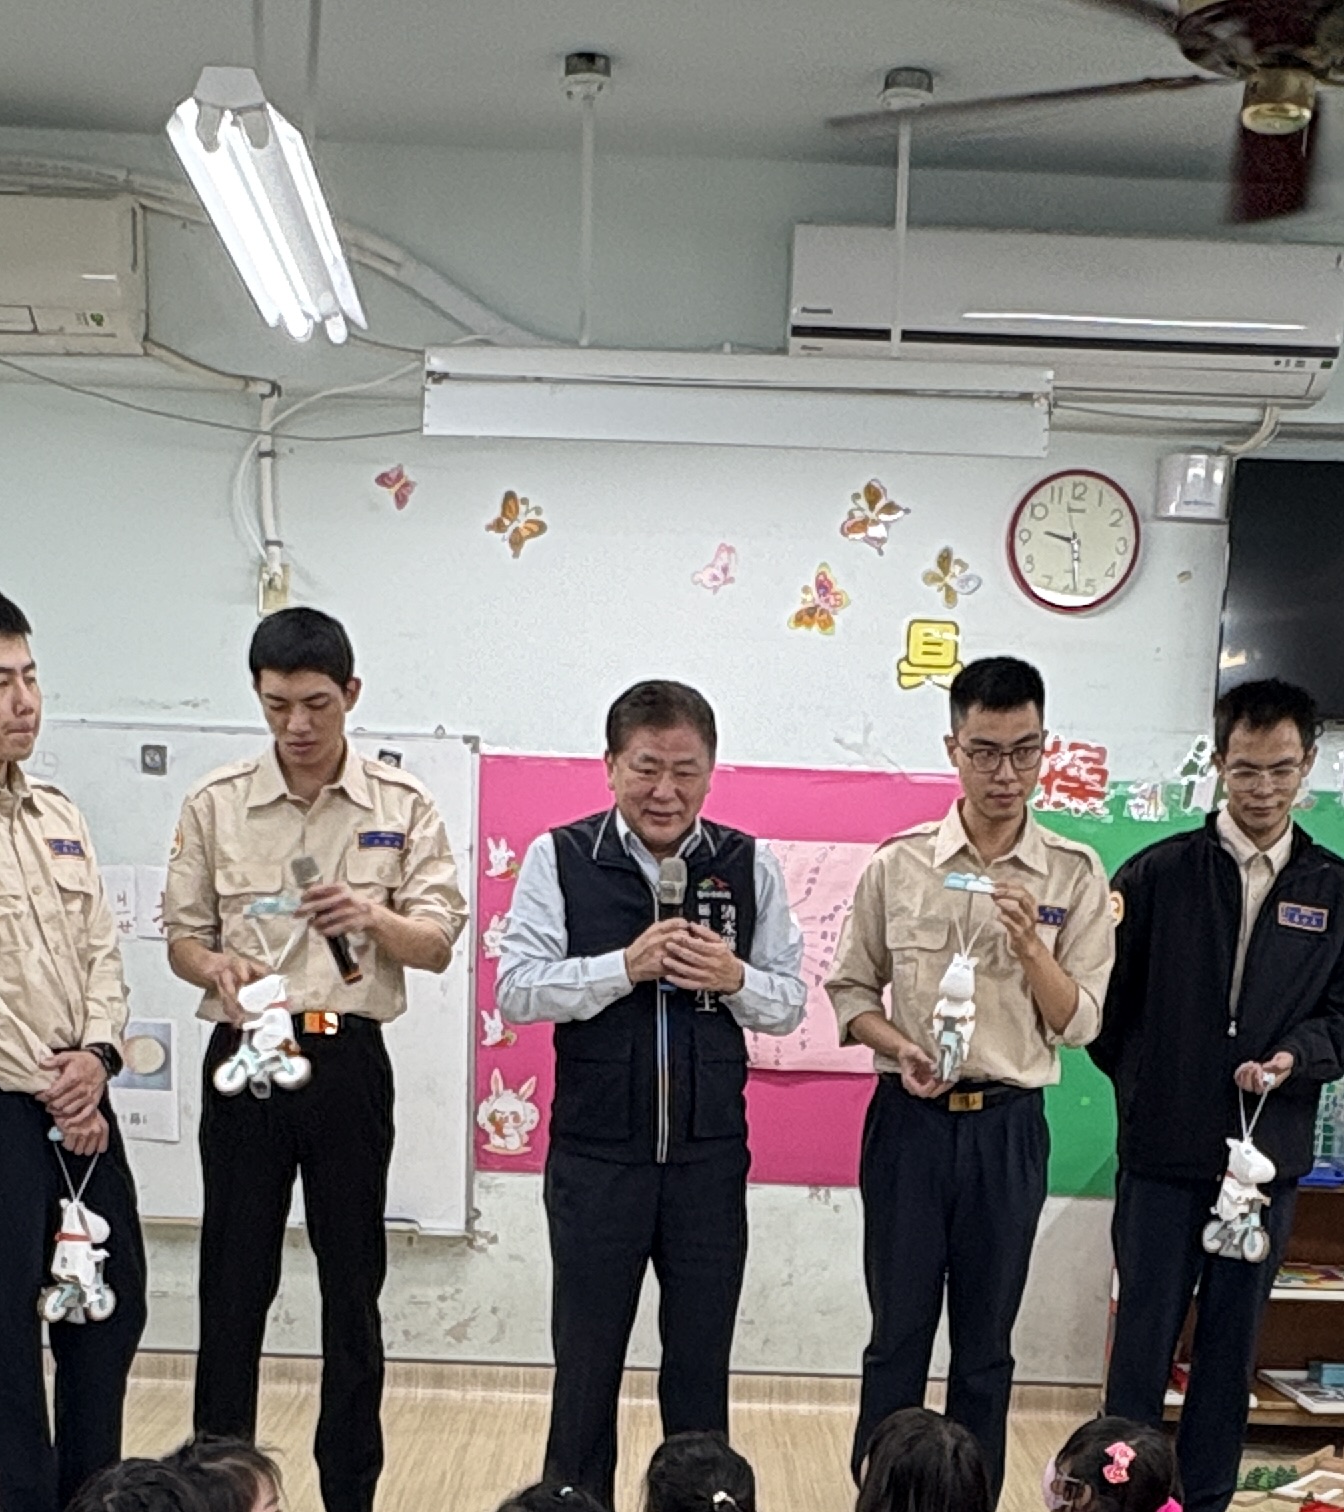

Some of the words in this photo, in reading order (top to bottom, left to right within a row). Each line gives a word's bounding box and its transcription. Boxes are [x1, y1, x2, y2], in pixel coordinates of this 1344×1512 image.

[1073, 482, 1087, 500] 12
[1031, 502, 1048, 521] 10
[1110, 509, 1123, 527] 2
[1019, 528, 1031, 545] 9
[1115, 537, 1127, 555] 3
[1023, 554, 1034, 573] 8
[1106, 561, 1116, 579] 4
